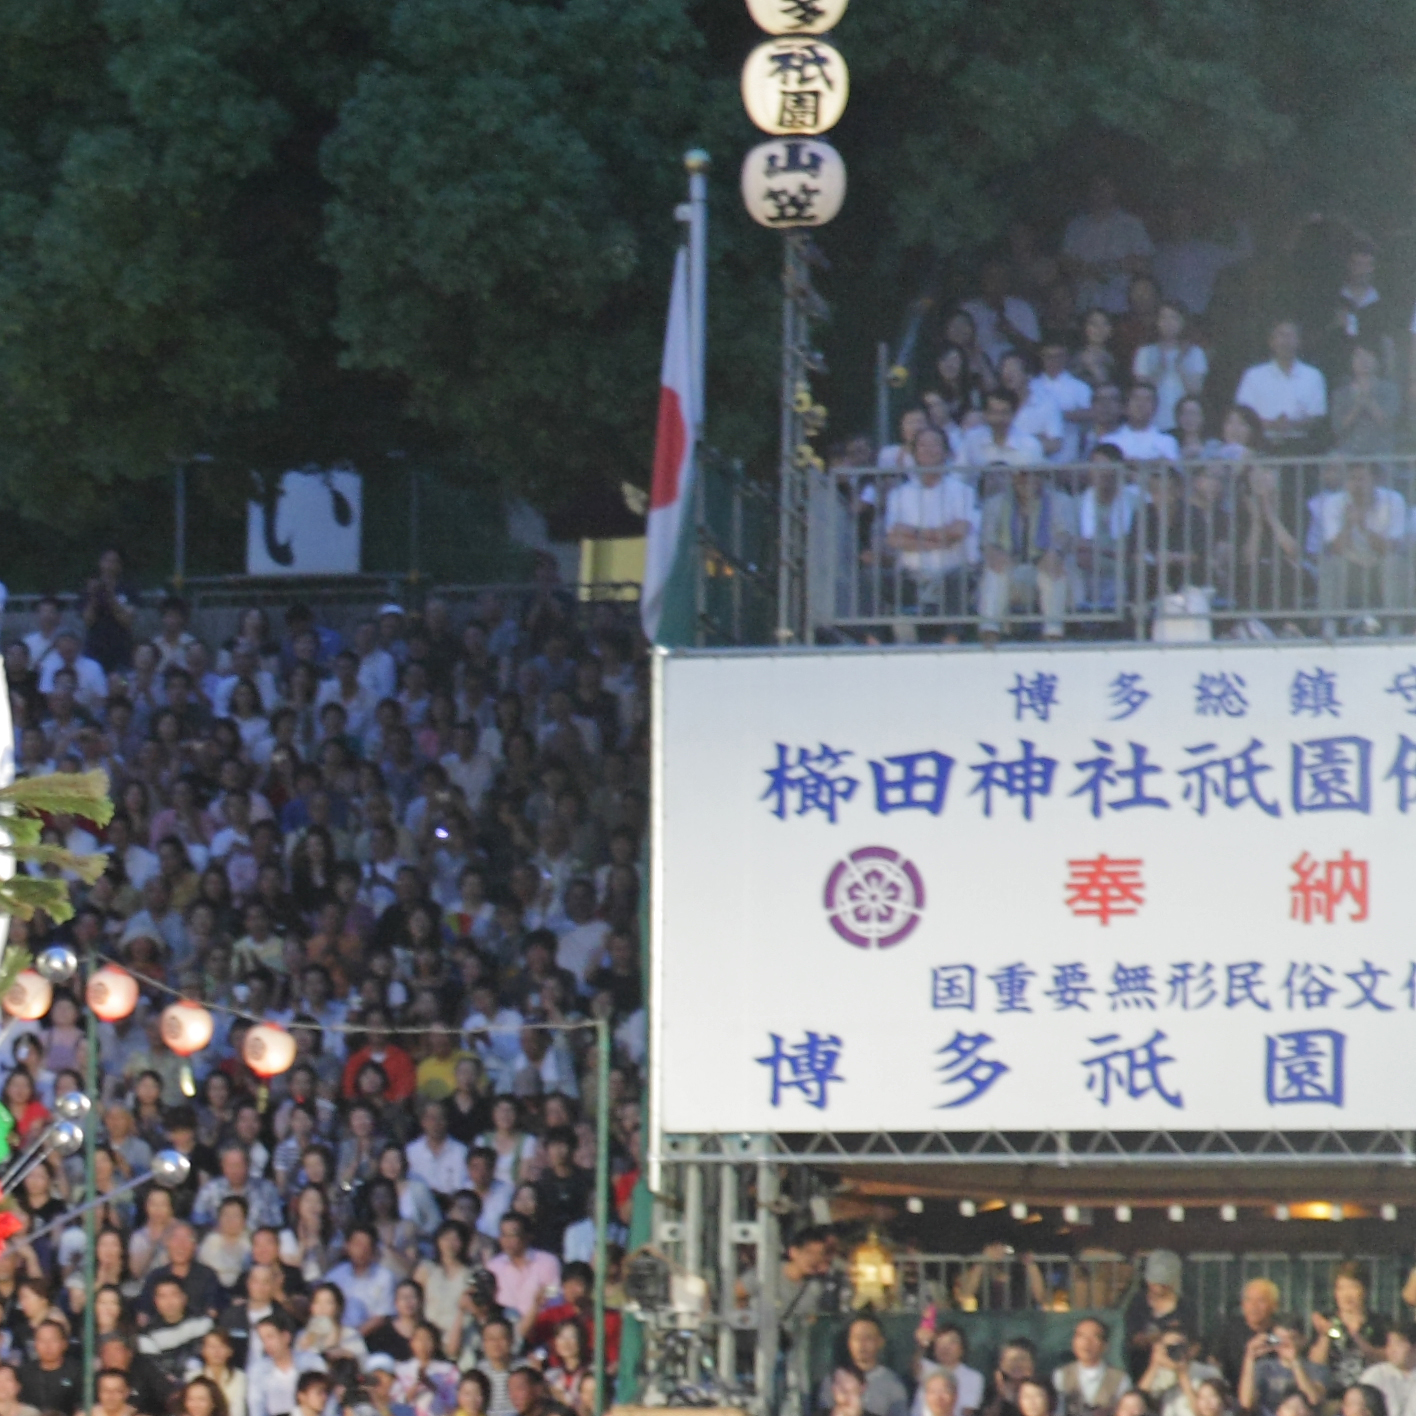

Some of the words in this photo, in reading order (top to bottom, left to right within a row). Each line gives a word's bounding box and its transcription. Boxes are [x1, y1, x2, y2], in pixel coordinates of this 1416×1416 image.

[1065, 850, 1371, 926] 奉納
[931, 960, 1416, 1013] 国重要無形民俗文
[756, 1029, 1347, 1109] 博多祇園
